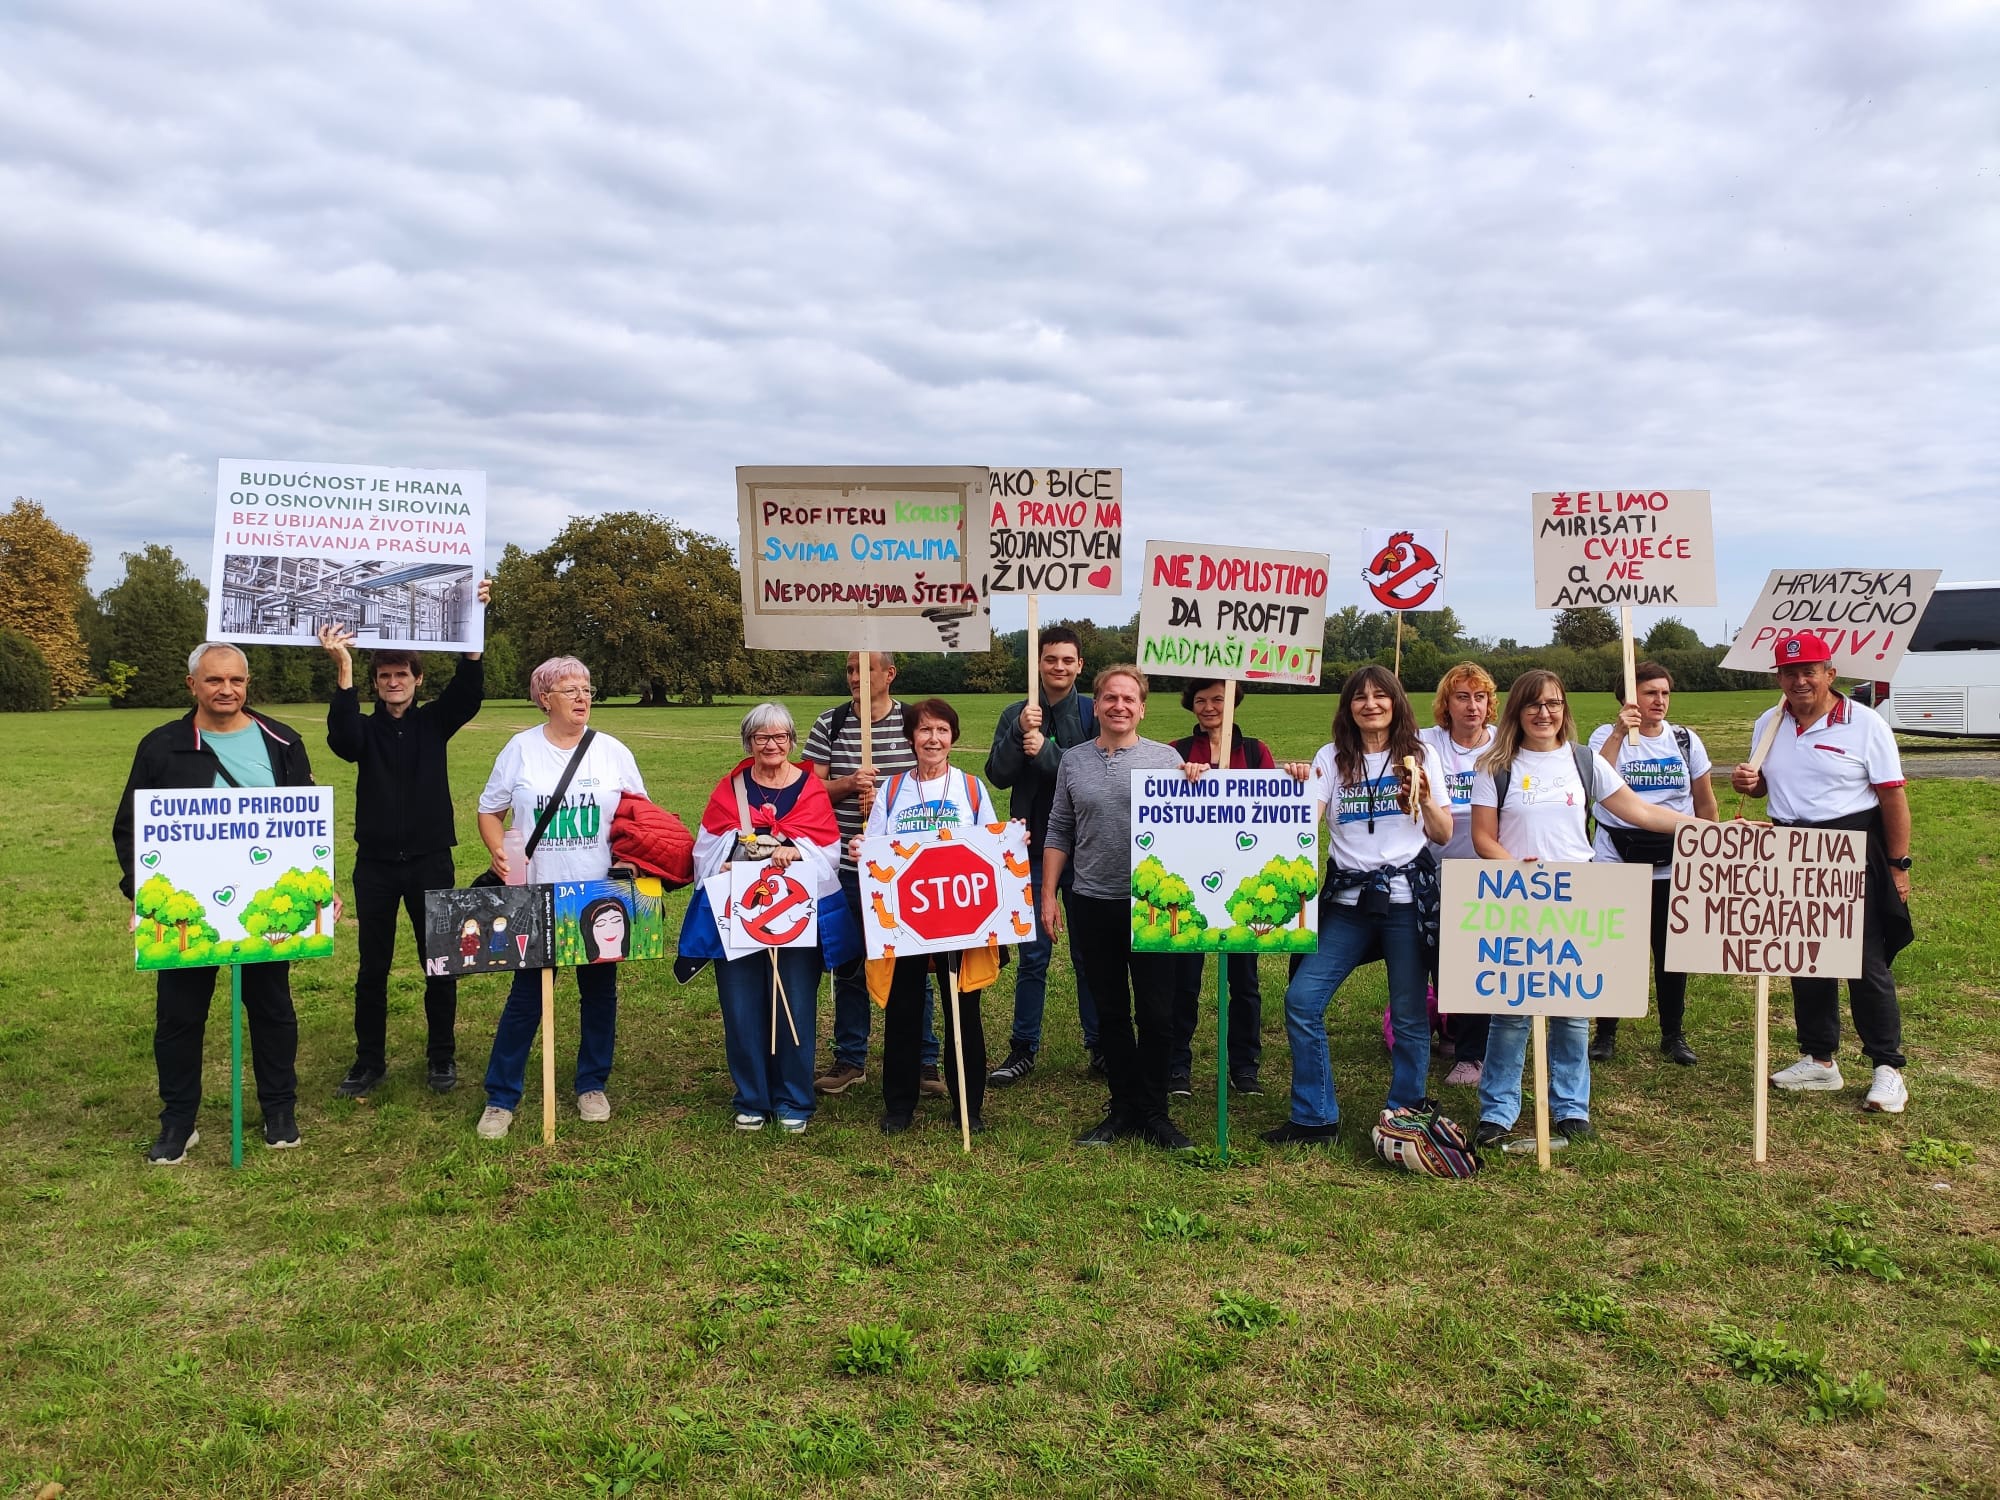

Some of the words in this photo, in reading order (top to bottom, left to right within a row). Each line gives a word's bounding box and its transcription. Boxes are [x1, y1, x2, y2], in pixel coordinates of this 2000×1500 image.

[240, 472, 366, 491] BUDUĆNOST
[370, 479, 389, 492] JE
[396, 480, 462, 496] HRANA
[1046, 468, 1113, 500] BIĆE
[230, 491, 259, 505] OD
[265, 493, 372, 511] OSNOVNIH
[378, 499, 471, 516] SIROVINA
[762, 501, 886, 526] PROFITERU
[1017, 500, 1087, 527] PRAVO
[1094, 502, 1121, 528] NA
[1551, 491, 1669, 515] ŽELIMO
[233, 512, 269, 526] BEZ
[275, 514, 364, 531] UBIJANJA
[369, 514, 466, 535] ŽIVOTINJA
[1540, 515, 1657, 538] MIRISATI
[226, 532, 230, 545] I
[237, 531, 370, 550] UNIŠTAVANJA
[376, 537, 471, 556] PRAŠUMA
[764, 536, 839, 562] SVIMA
[851, 533, 960, 561] OSTALIMA
[990, 528, 1121, 560] STOJANSTVEN
[1584, 534, 1691, 560] CVIJEĆE
[990, 559, 1090, 591] ŽIVOT
[1153, 554, 1194, 588] NE
[1196, 554, 1328, 598] DOPUSTIMO
[1606, 561, 1644, 581] NE
[1772, 571, 1912, 597] HRVATSKA
[1551, 584, 1678, 606] AMONIJAK
[1168, 596, 1202, 628] DA
[1217, 600, 1309, 636] PROFIT
[1772, 595, 1917, 625] ODLUČNO
[1142, 634, 1246, 668] NADMAŠI
[1144, 775, 1219, 798] ČUVAMO
[1225, 779, 1304, 798] PRIRODU
[150, 794, 231, 817] ČUVAMO
[238, 795, 320, 815] PRIRODU
[1138, 801, 1246, 824] POŠTUJEMO
[1251, 801, 1311, 824] ŽIVOTE
[143, 820, 260, 843] POŠTUJEMO
[266, 817, 327, 839] ŽIVOTE
[1788, 830, 1856, 864] PLIVA
[910, 872, 989, 914] STOP
[1478, 863, 1572, 902] NAŠE
[1674, 862, 1691, 892] U
[1699, 861, 1785, 899] SMEĆU,
[1793, 867, 1866, 903] FEKALIJE
[1460, 902, 1625, 948] ZDRAVLJE
[1670, 895, 1689, 934] S
[1704, 896, 1853, 939] MEGAFARMI
[1478, 937, 1583, 966] NEMA
[1722, 936, 1821, 974] NEĆU!
[426, 956, 449, 976] NE
[1475, 970, 1603, 1006] CIJENU
